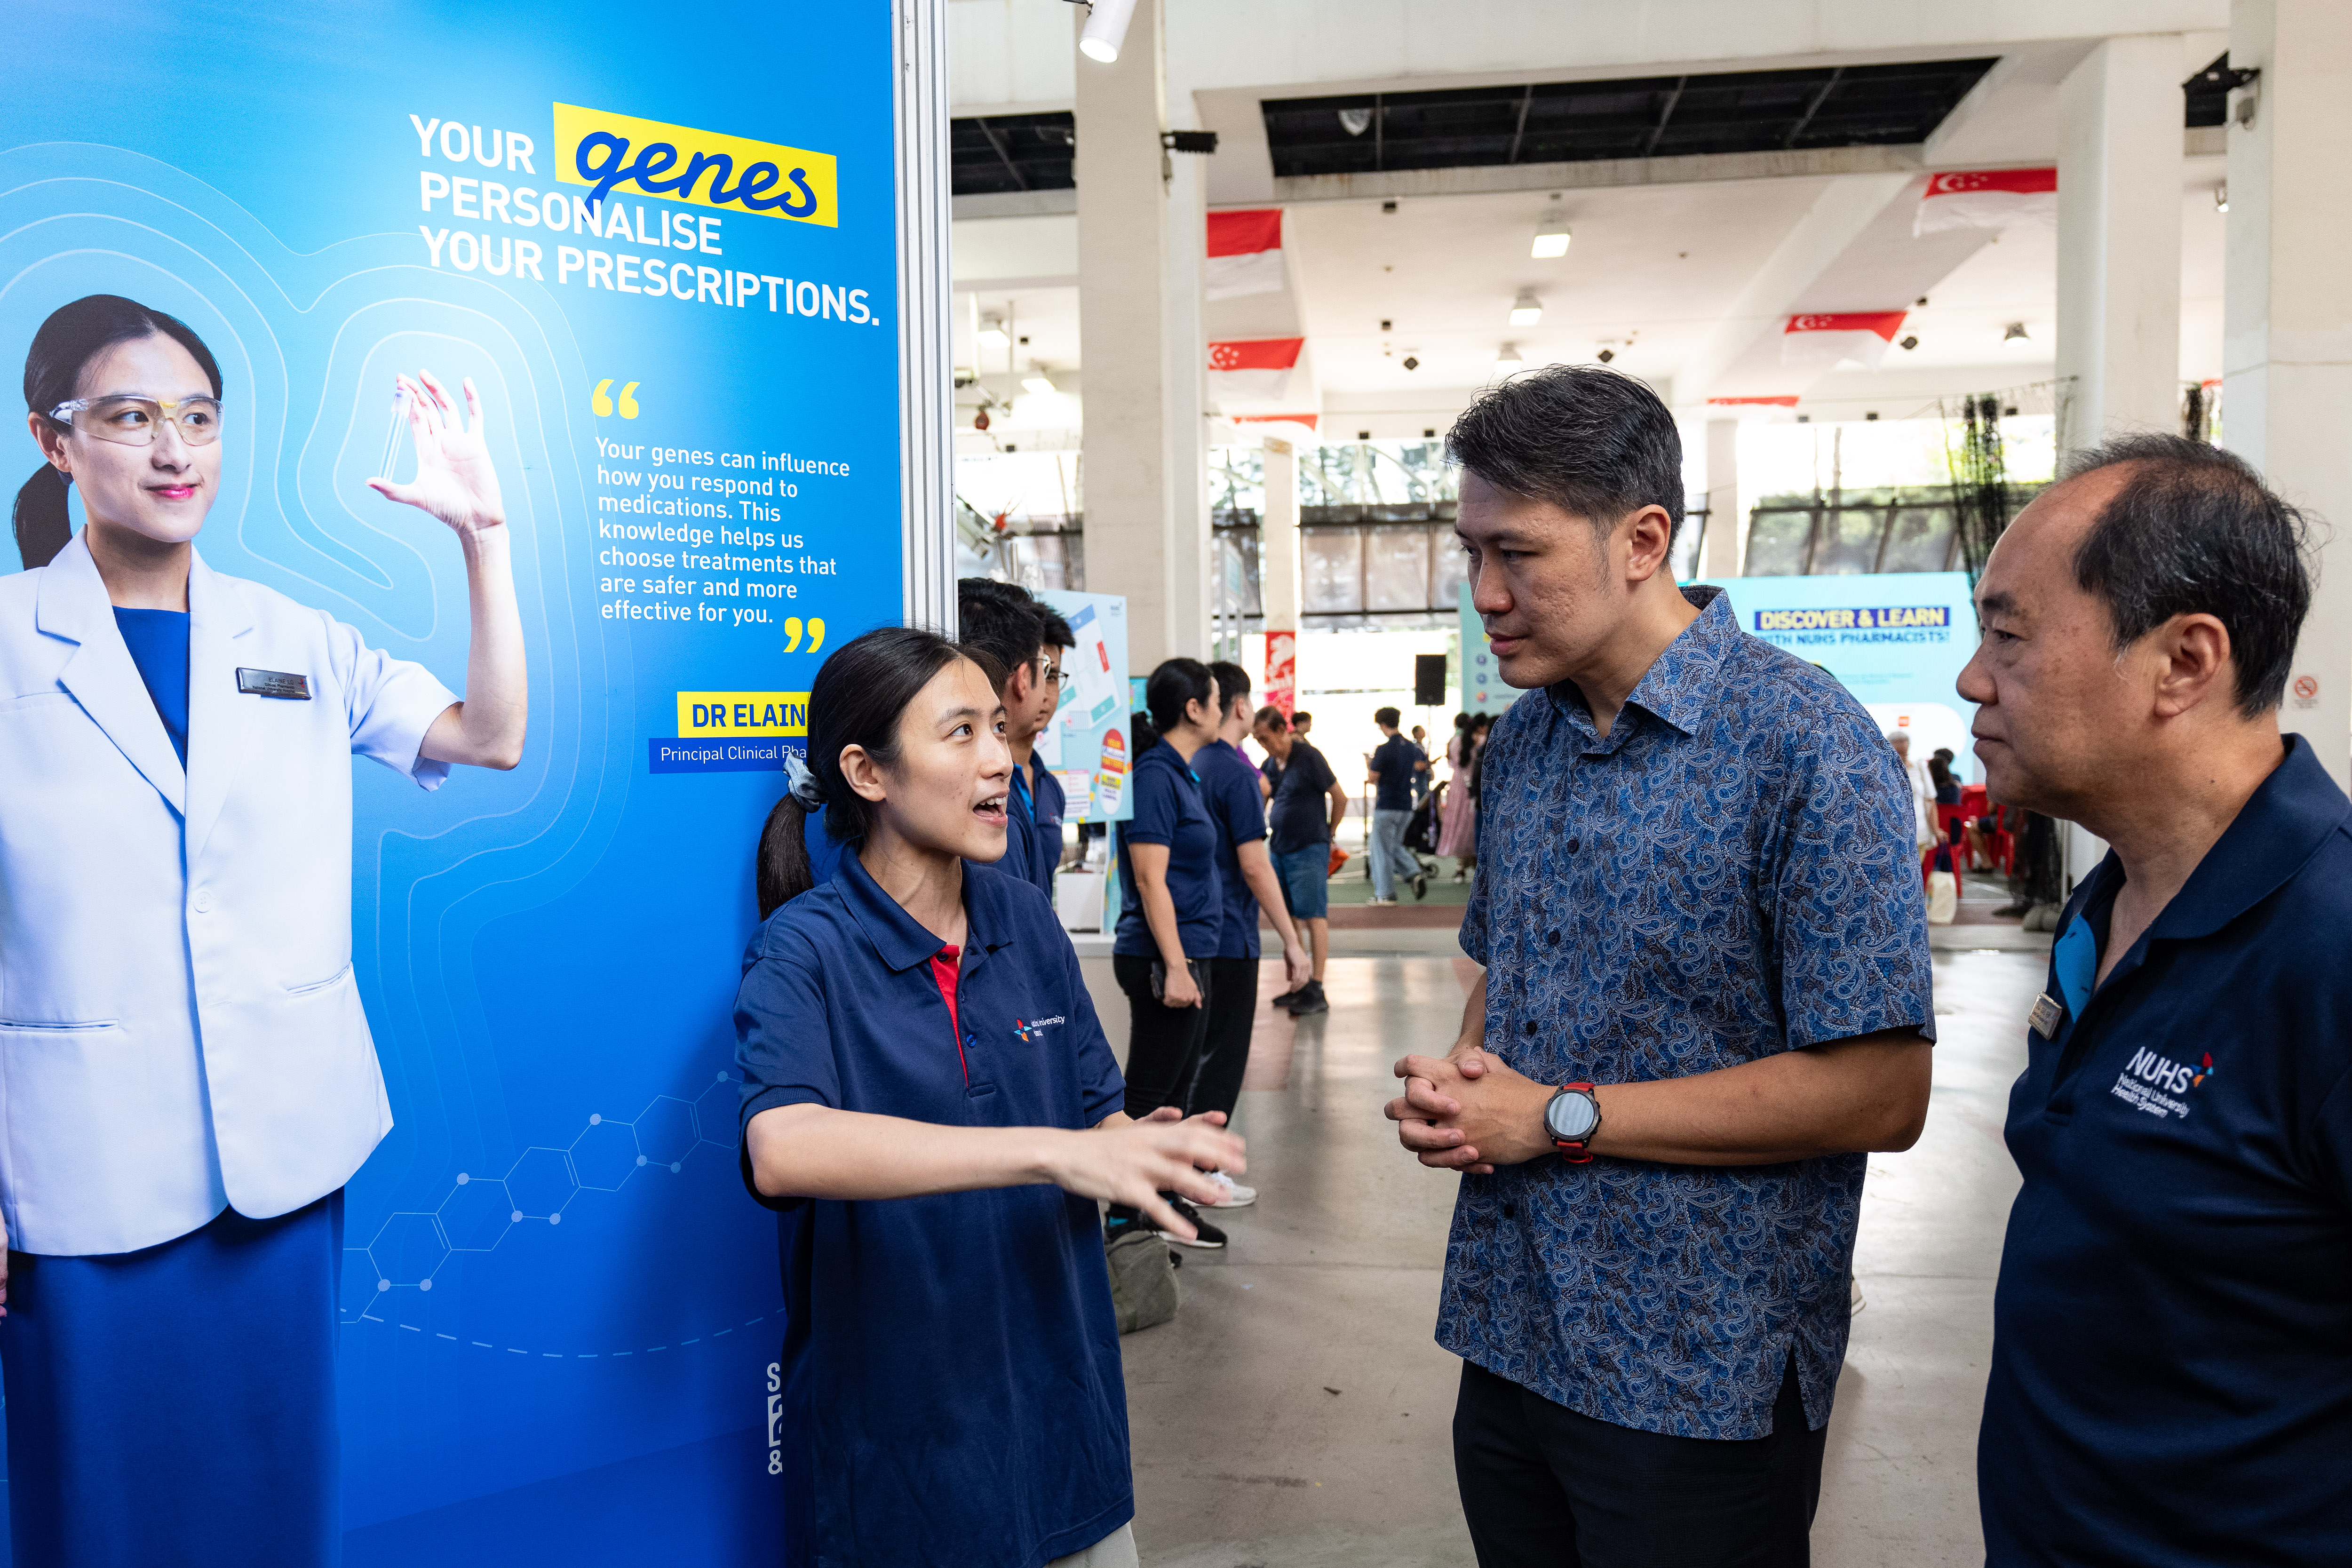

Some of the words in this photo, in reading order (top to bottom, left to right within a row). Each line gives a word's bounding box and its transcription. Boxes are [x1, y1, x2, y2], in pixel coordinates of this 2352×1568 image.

[409, 114, 534, 175] YOUR
[576, 131, 818, 222] genes
[421, 171, 723, 255] PERSONALISE
[419, 225, 544, 281] YOUR
[558, 246, 879, 326] PRESCRIPTIONS.
[596, 437, 645, 460] Your
[652, 447, 715, 467] genes
[720, 453, 755, 469] can
[762, 451, 850, 477] influence
[597, 464, 642, 486] how
[647, 473, 684, 493] you
[691, 476, 773, 498] respond
[779, 479, 798, 498] to
[598, 493, 733, 519] medications.
[739, 500, 781, 522] This
[599, 518, 714, 548] knowledge
[721, 525, 775, 551] helps
[781, 533, 804, 549] us
[600, 546, 675, 568] choose
[681, 550, 794, 573] treatments
[799, 555, 837, 575] that
[600, 577, 636, 593] are
[643, 574, 697, 595] safer
[703, 577, 739, 597] and
[747, 583, 797, 599] more
[601, 599, 691, 621] effective
[698, 602, 728, 622] for
[732, 608, 773, 627] you.
[1760, 609, 1855, 629] DISCOVER
[1858, 609, 1874, 628] &
[1877, 607, 1945, 627] LEARN
[692, 704, 726, 727] DR
[734, 704, 805, 727] ELAIN
[661, 747, 724, 764] Principal
[728, 746, 778, 760] Clinical
[782, 745, 806, 758] Pha
[2125, 1046, 2193, 1094] NUHS
[2111, 1082, 2140, 1105] Health
[2117, 1073, 2153, 1098] National
